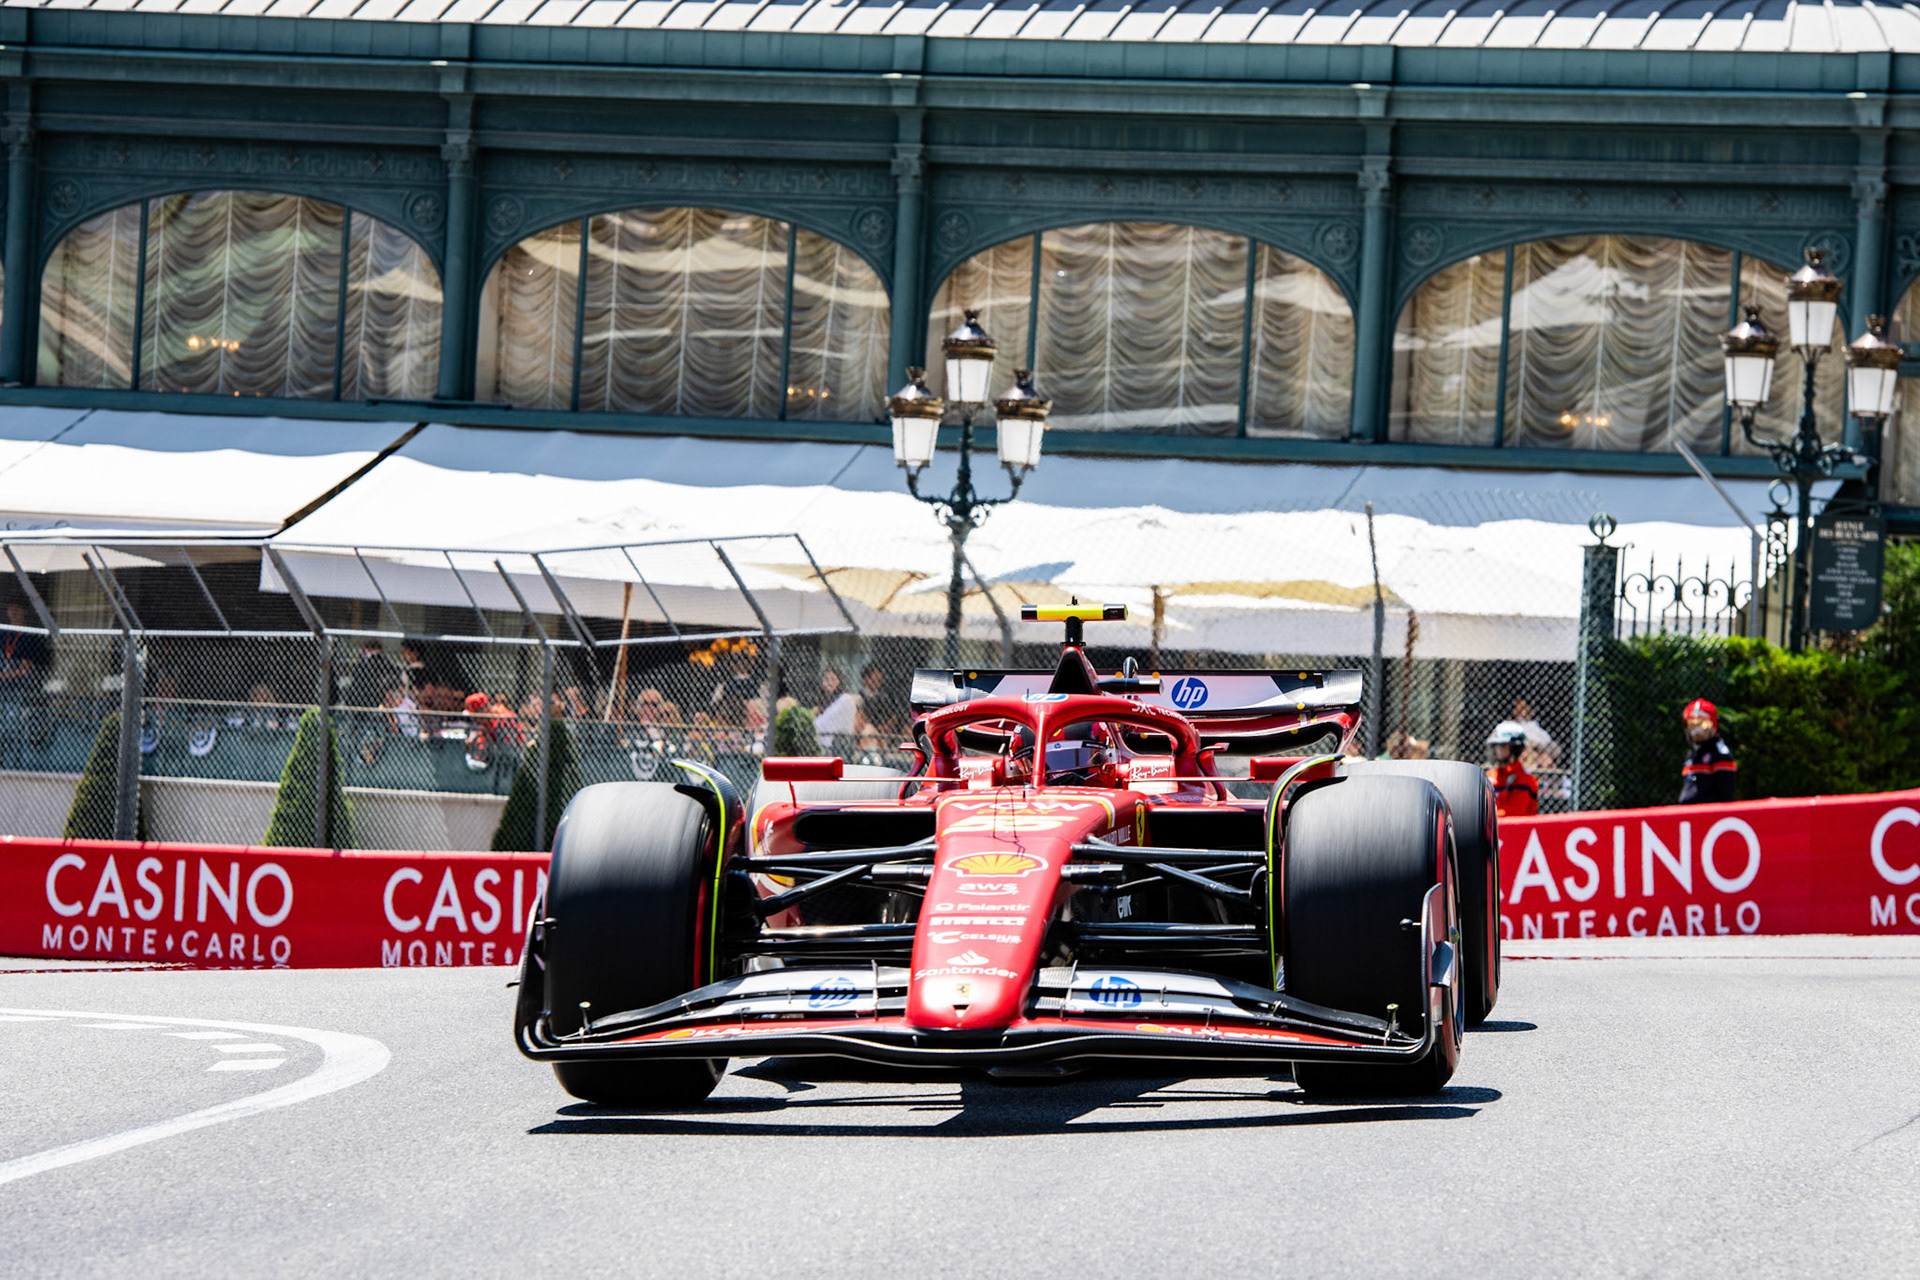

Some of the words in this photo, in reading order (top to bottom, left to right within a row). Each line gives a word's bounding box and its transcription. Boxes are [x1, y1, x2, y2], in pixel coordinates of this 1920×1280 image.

[1173, 677, 1206, 709] hp
[1127, 765, 1168, 780] Ray-Ban
[1500, 817, 1760, 905] ASINO
[46, 854, 293, 927] CASINO
[958, 883, 1017, 891] aws
[957, 903, 1030, 911] Palantir
[1626, 901, 1761, 935] CARLO
[42, 924, 156, 956] MONTE
[181, 930, 292, 963] CARLO
[914, 966, 1018, 981] Santander
